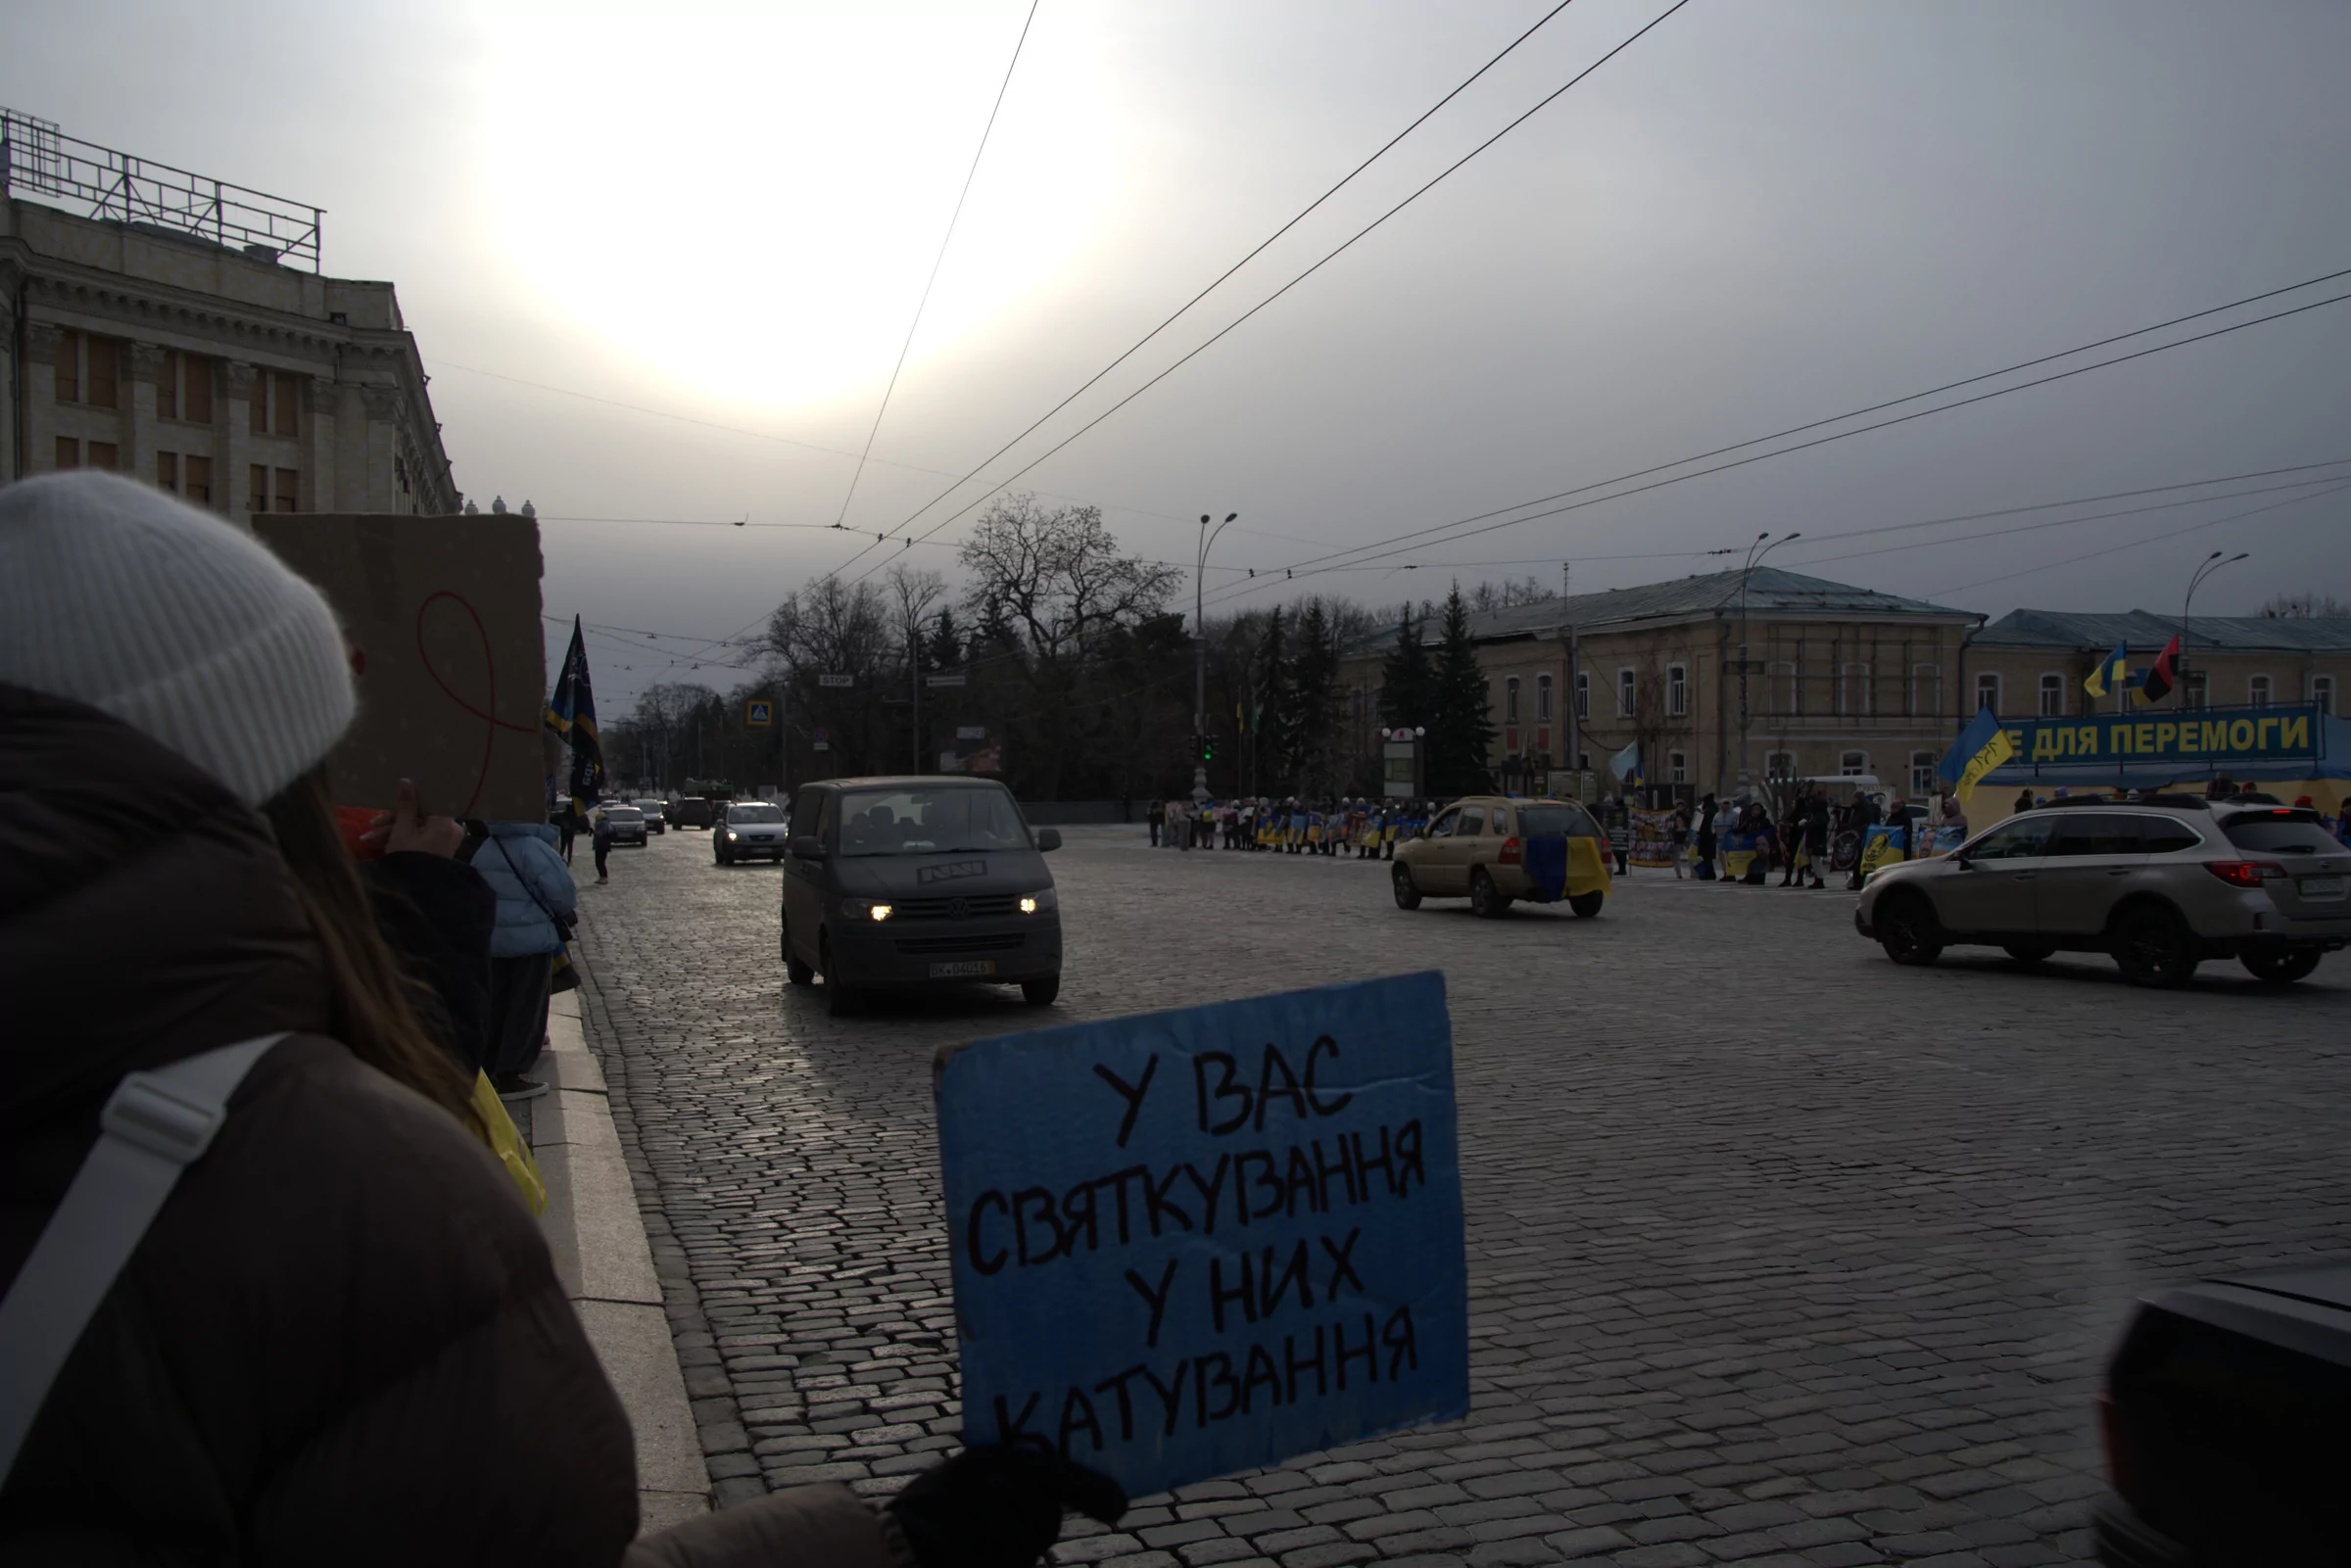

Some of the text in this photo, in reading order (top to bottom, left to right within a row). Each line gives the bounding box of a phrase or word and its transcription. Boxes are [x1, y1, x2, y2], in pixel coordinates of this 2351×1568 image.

[2032, 726, 2098, 762] ДЛЯ
[2110, 716, 2309, 754] ПЕРЕМОГИ
[1093, 1034, 1353, 1148] У ВАС
[968, 1119, 1425, 1275] СВЯТКУВАННЯ
[1125, 1227, 1366, 1348] У НИХ
[993, 1306, 1417, 1457] КАТУВАННЯ
